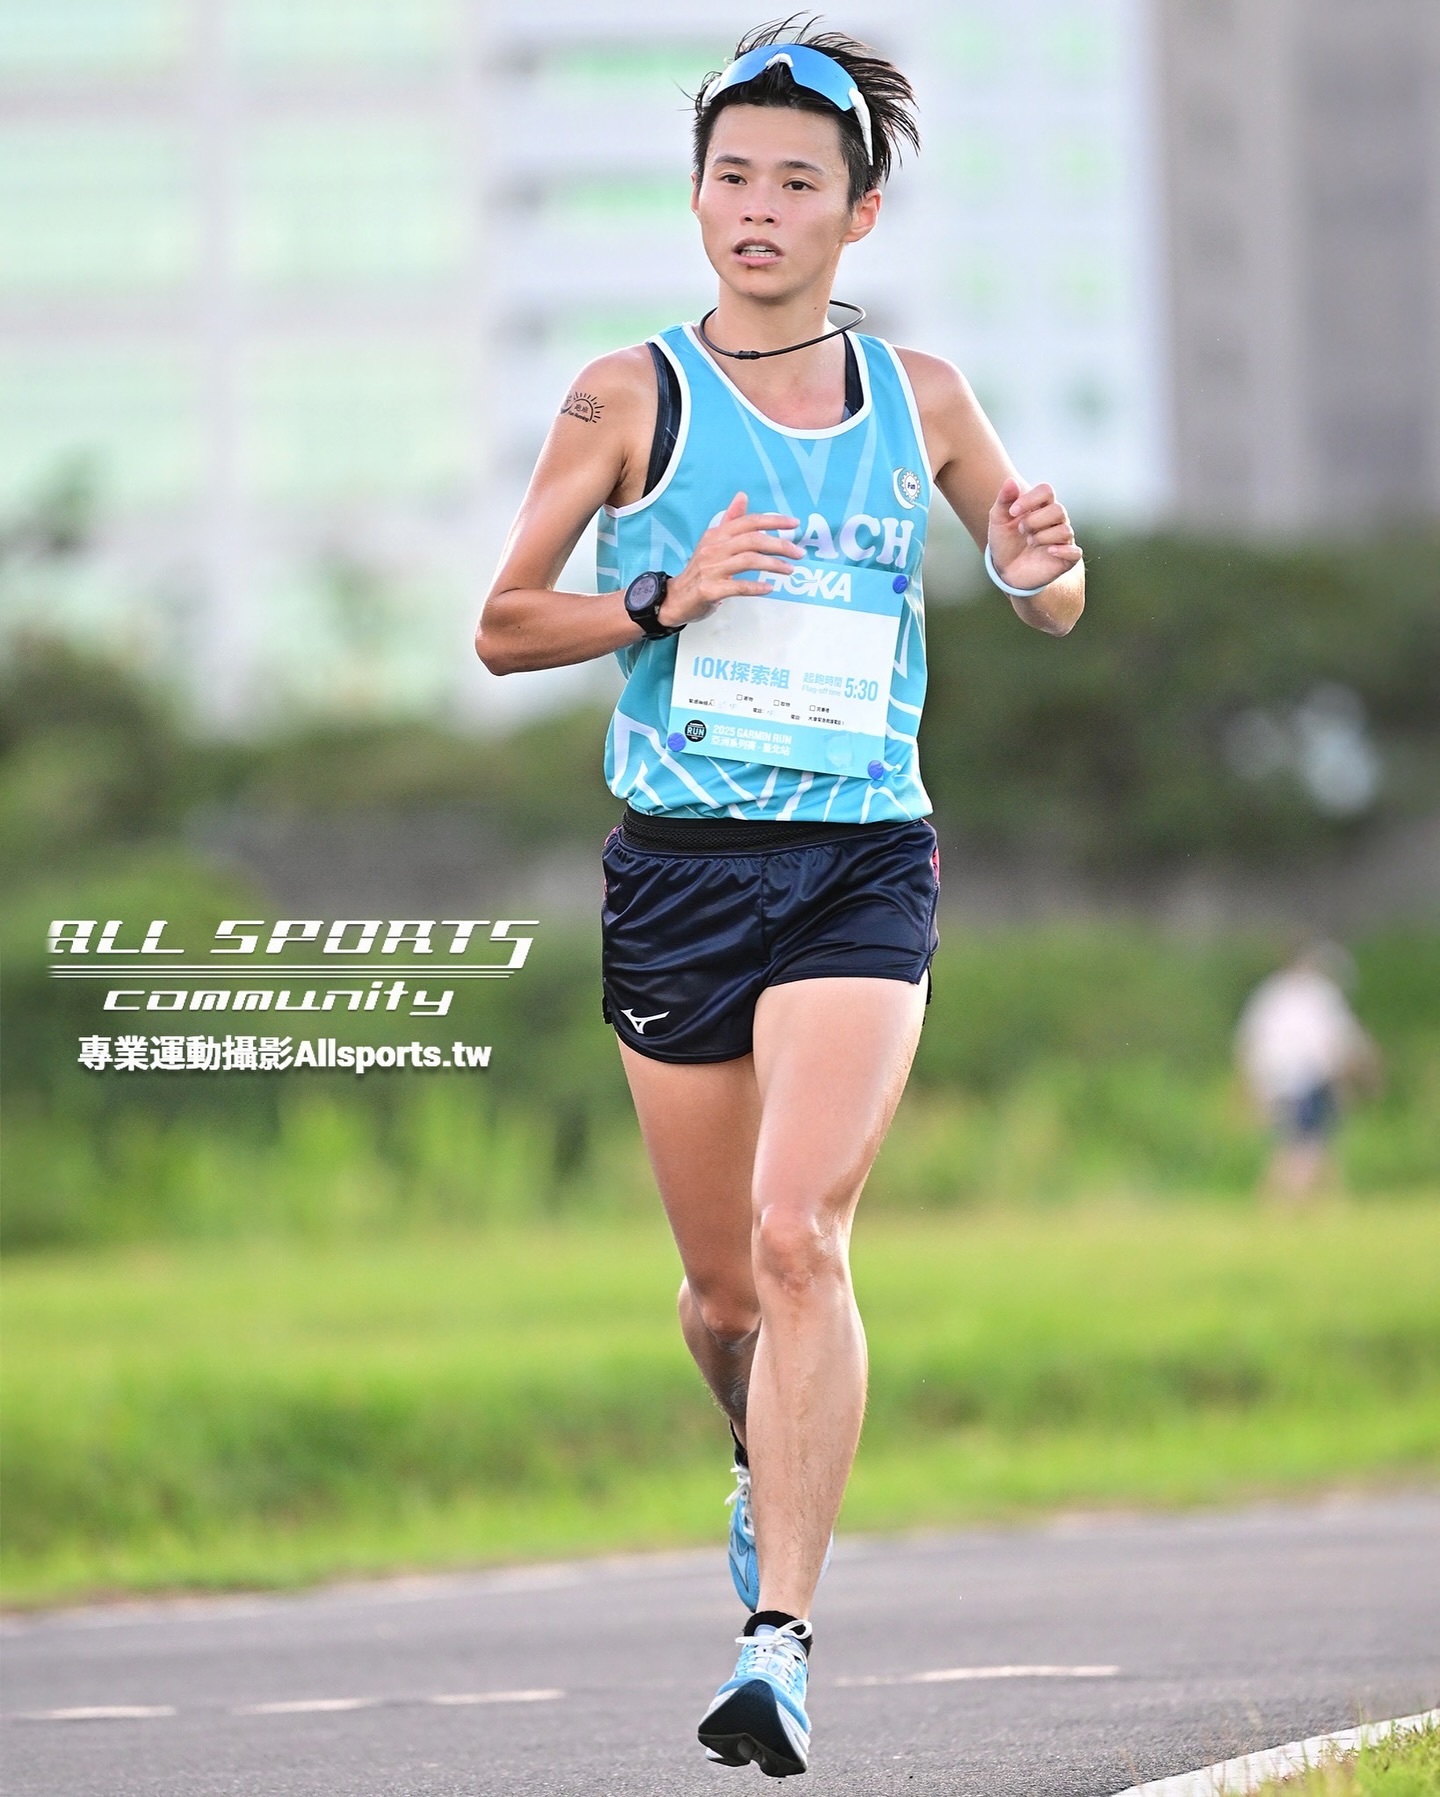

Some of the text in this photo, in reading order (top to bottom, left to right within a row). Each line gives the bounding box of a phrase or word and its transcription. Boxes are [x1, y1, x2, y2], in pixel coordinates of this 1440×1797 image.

[708, 510, 914, 568] ACH
[692, 656, 790, 690] 10K探索組
[844, 677, 879, 701] 5:30
[686, 726, 705, 737] RUN
[712, 724, 736, 736] 2025
[736, 727, 771, 742] GARMIN
[771, 733, 792, 745] RUN
